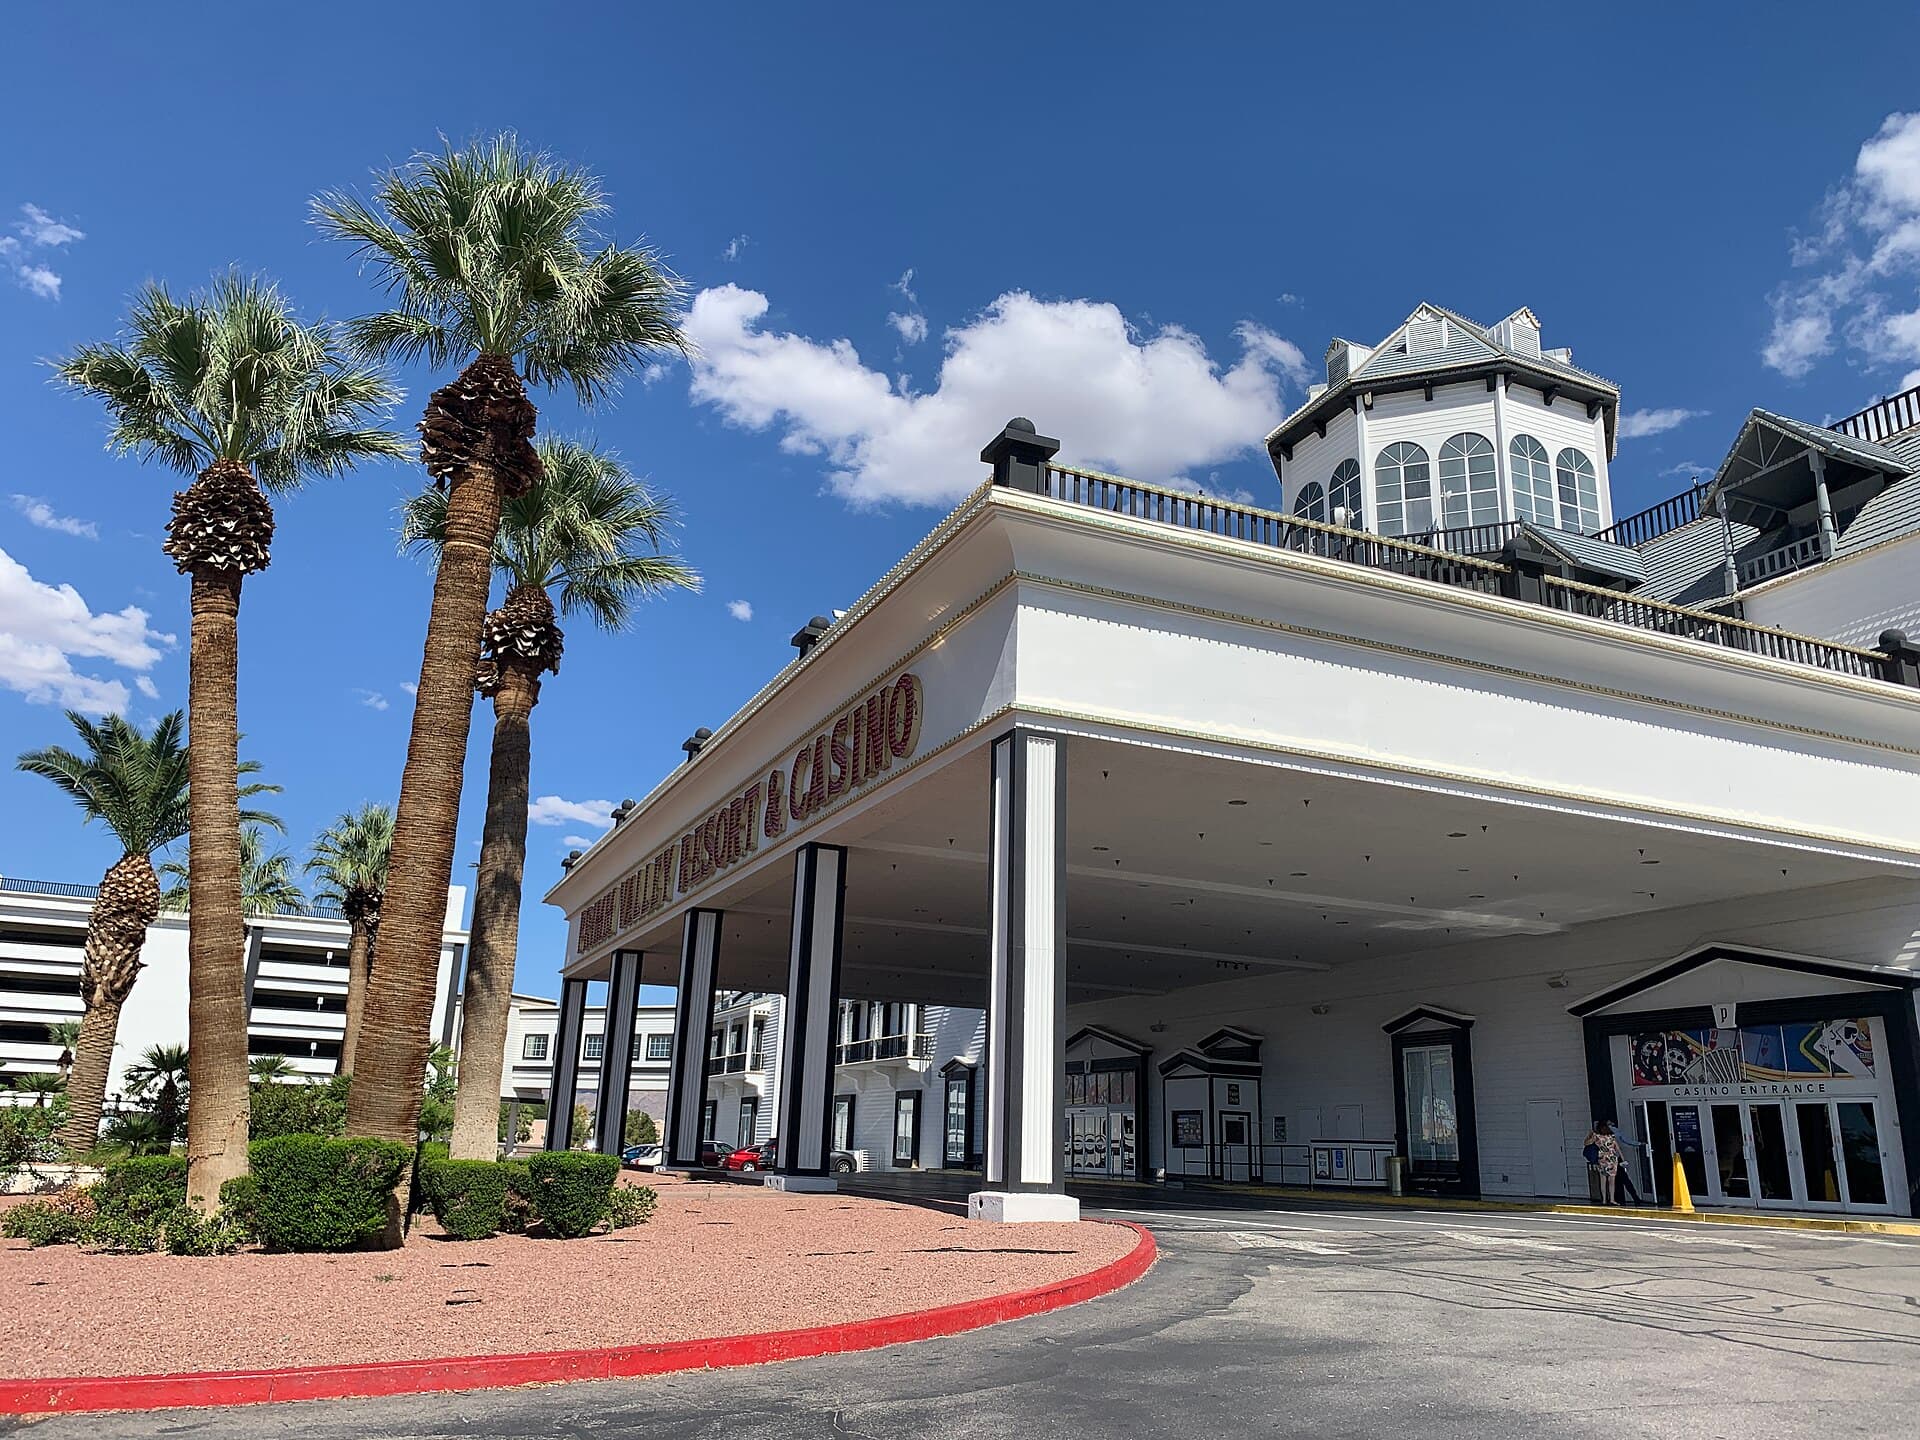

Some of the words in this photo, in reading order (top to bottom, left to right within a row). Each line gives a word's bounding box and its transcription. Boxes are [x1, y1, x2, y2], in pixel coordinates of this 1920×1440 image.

[678, 782, 766, 893] RESORT
[764, 770, 788, 838] &
[789, 673, 923, 820] CASINO
[1674, 1086, 1729, 1096] CASINO
[1740, 1083, 1826, 1095] ENTRANCE
